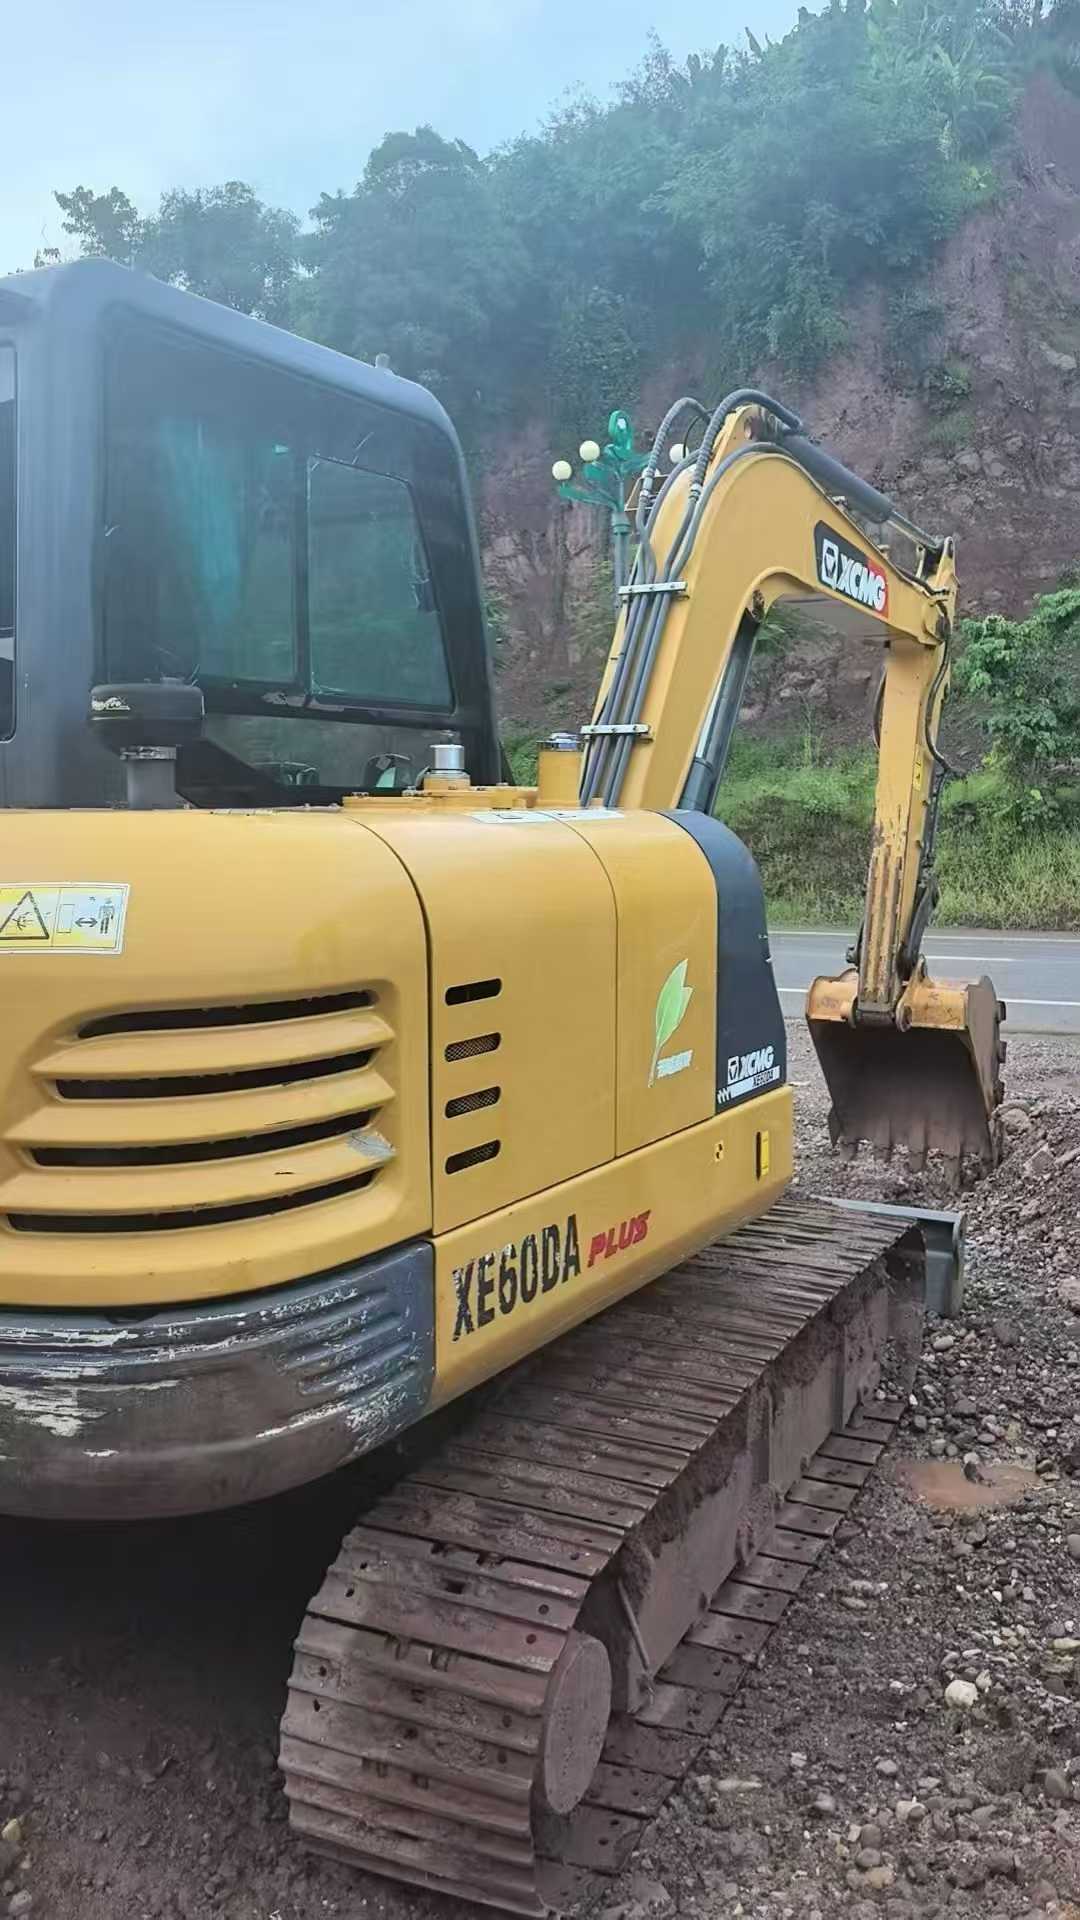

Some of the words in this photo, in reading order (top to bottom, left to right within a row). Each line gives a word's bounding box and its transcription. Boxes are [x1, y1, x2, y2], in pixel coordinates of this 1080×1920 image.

[837, 553, 886, 612] XCMG
[738, 1045, 774, 1080] XCMG
[452, 1214, 580, 1341] XE60DA
[587, 1209, 651, 1268] PLUS
